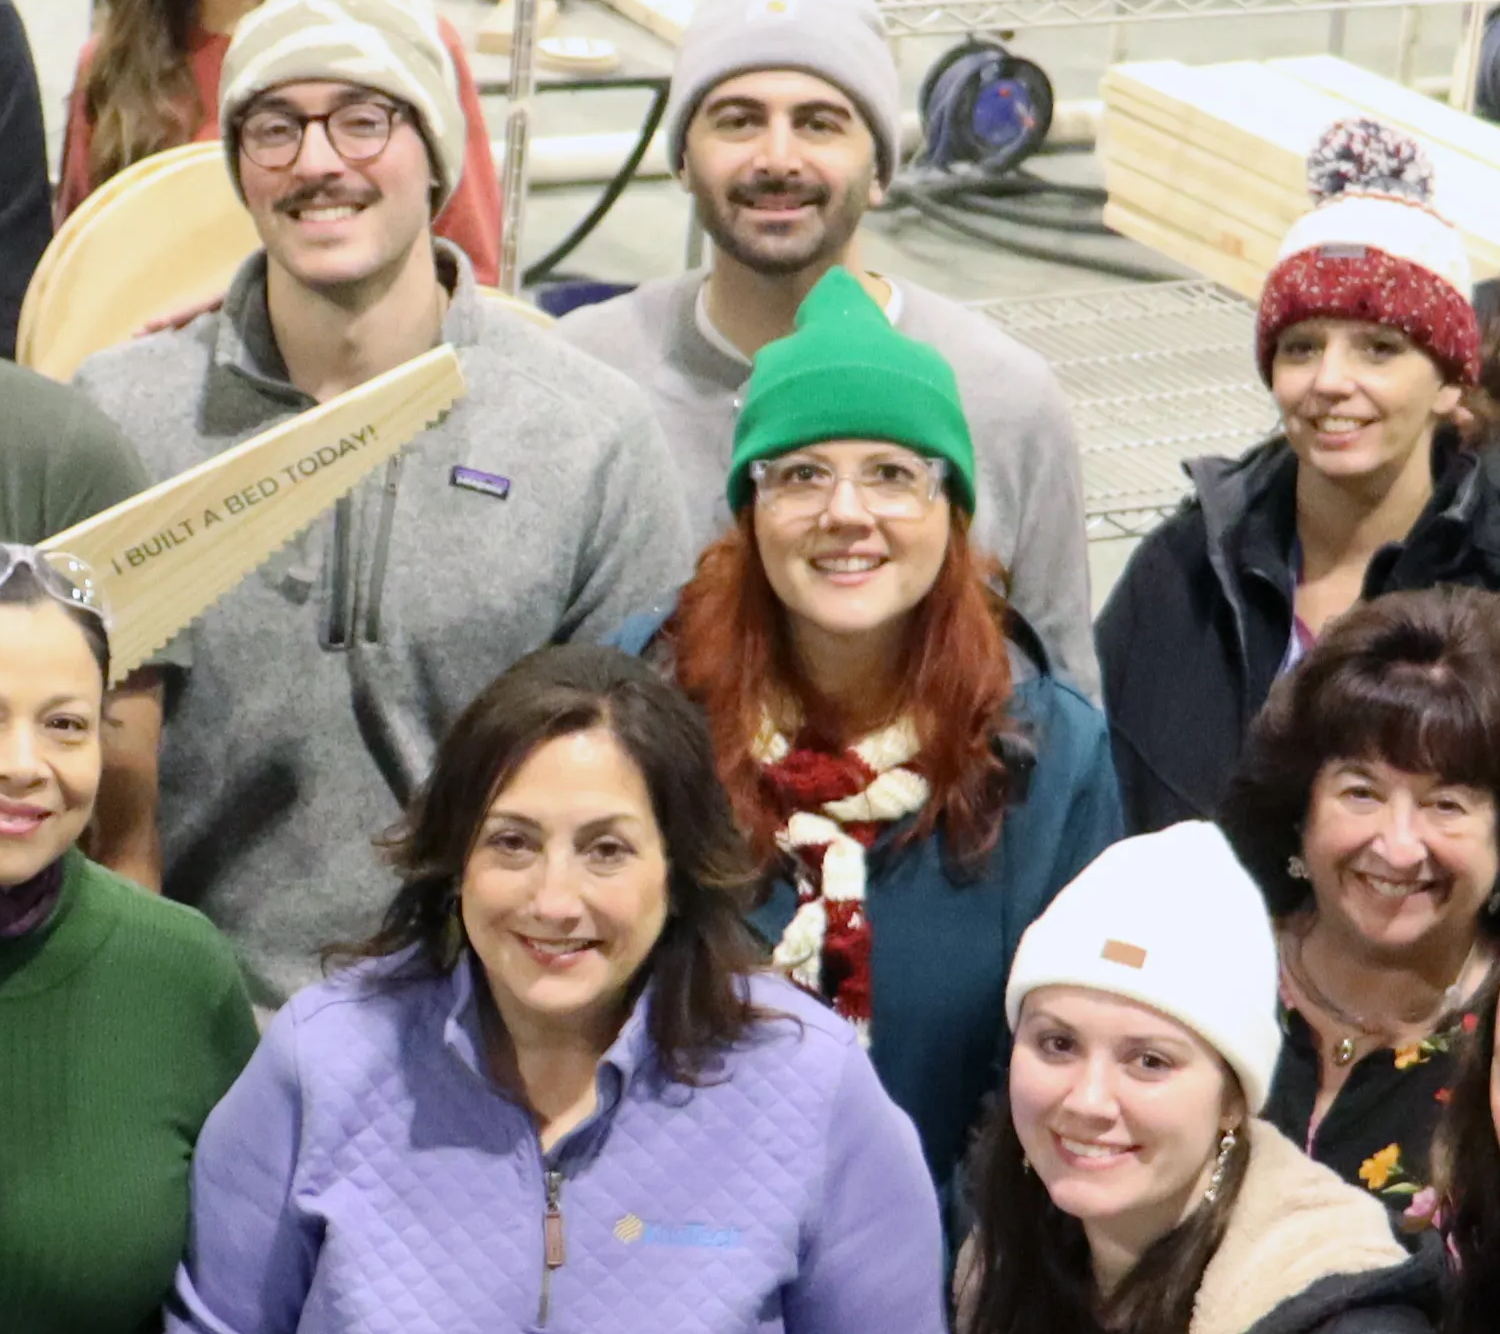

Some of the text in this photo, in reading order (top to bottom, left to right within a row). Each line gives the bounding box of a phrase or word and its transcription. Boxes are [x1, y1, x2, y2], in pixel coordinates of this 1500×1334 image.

[111, 424, 380, 576] I BUILT A BED TODAY!
